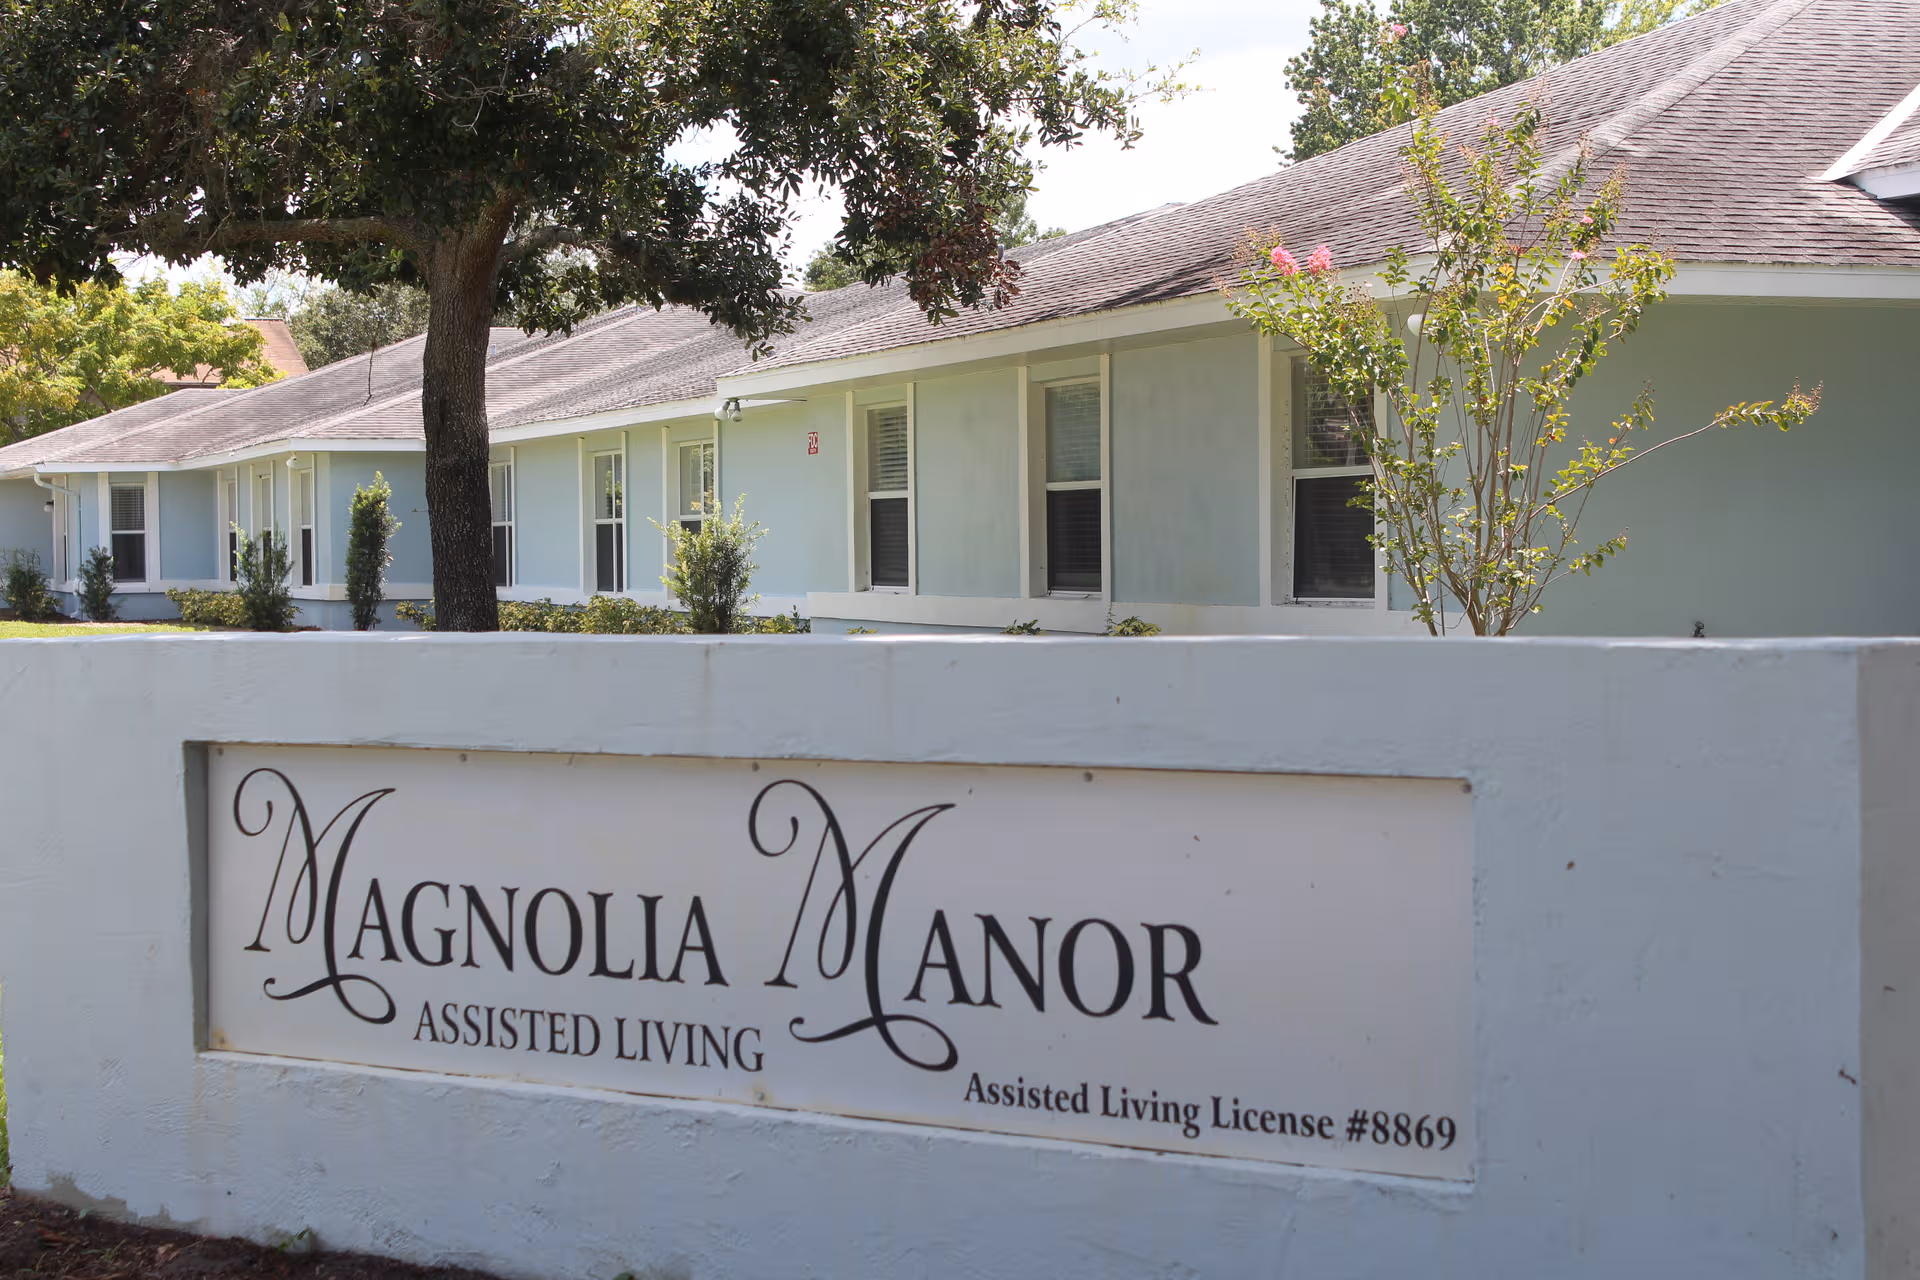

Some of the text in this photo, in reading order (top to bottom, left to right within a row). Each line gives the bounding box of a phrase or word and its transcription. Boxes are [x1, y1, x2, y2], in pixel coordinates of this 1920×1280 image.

[233, 767, 1219, 1073] MAGNOLIA MANOR
[412, 1000, 765, 1073] ASSISTED LIVING
[964, 1072, 1457, 1151] Assisted Living License #8869
